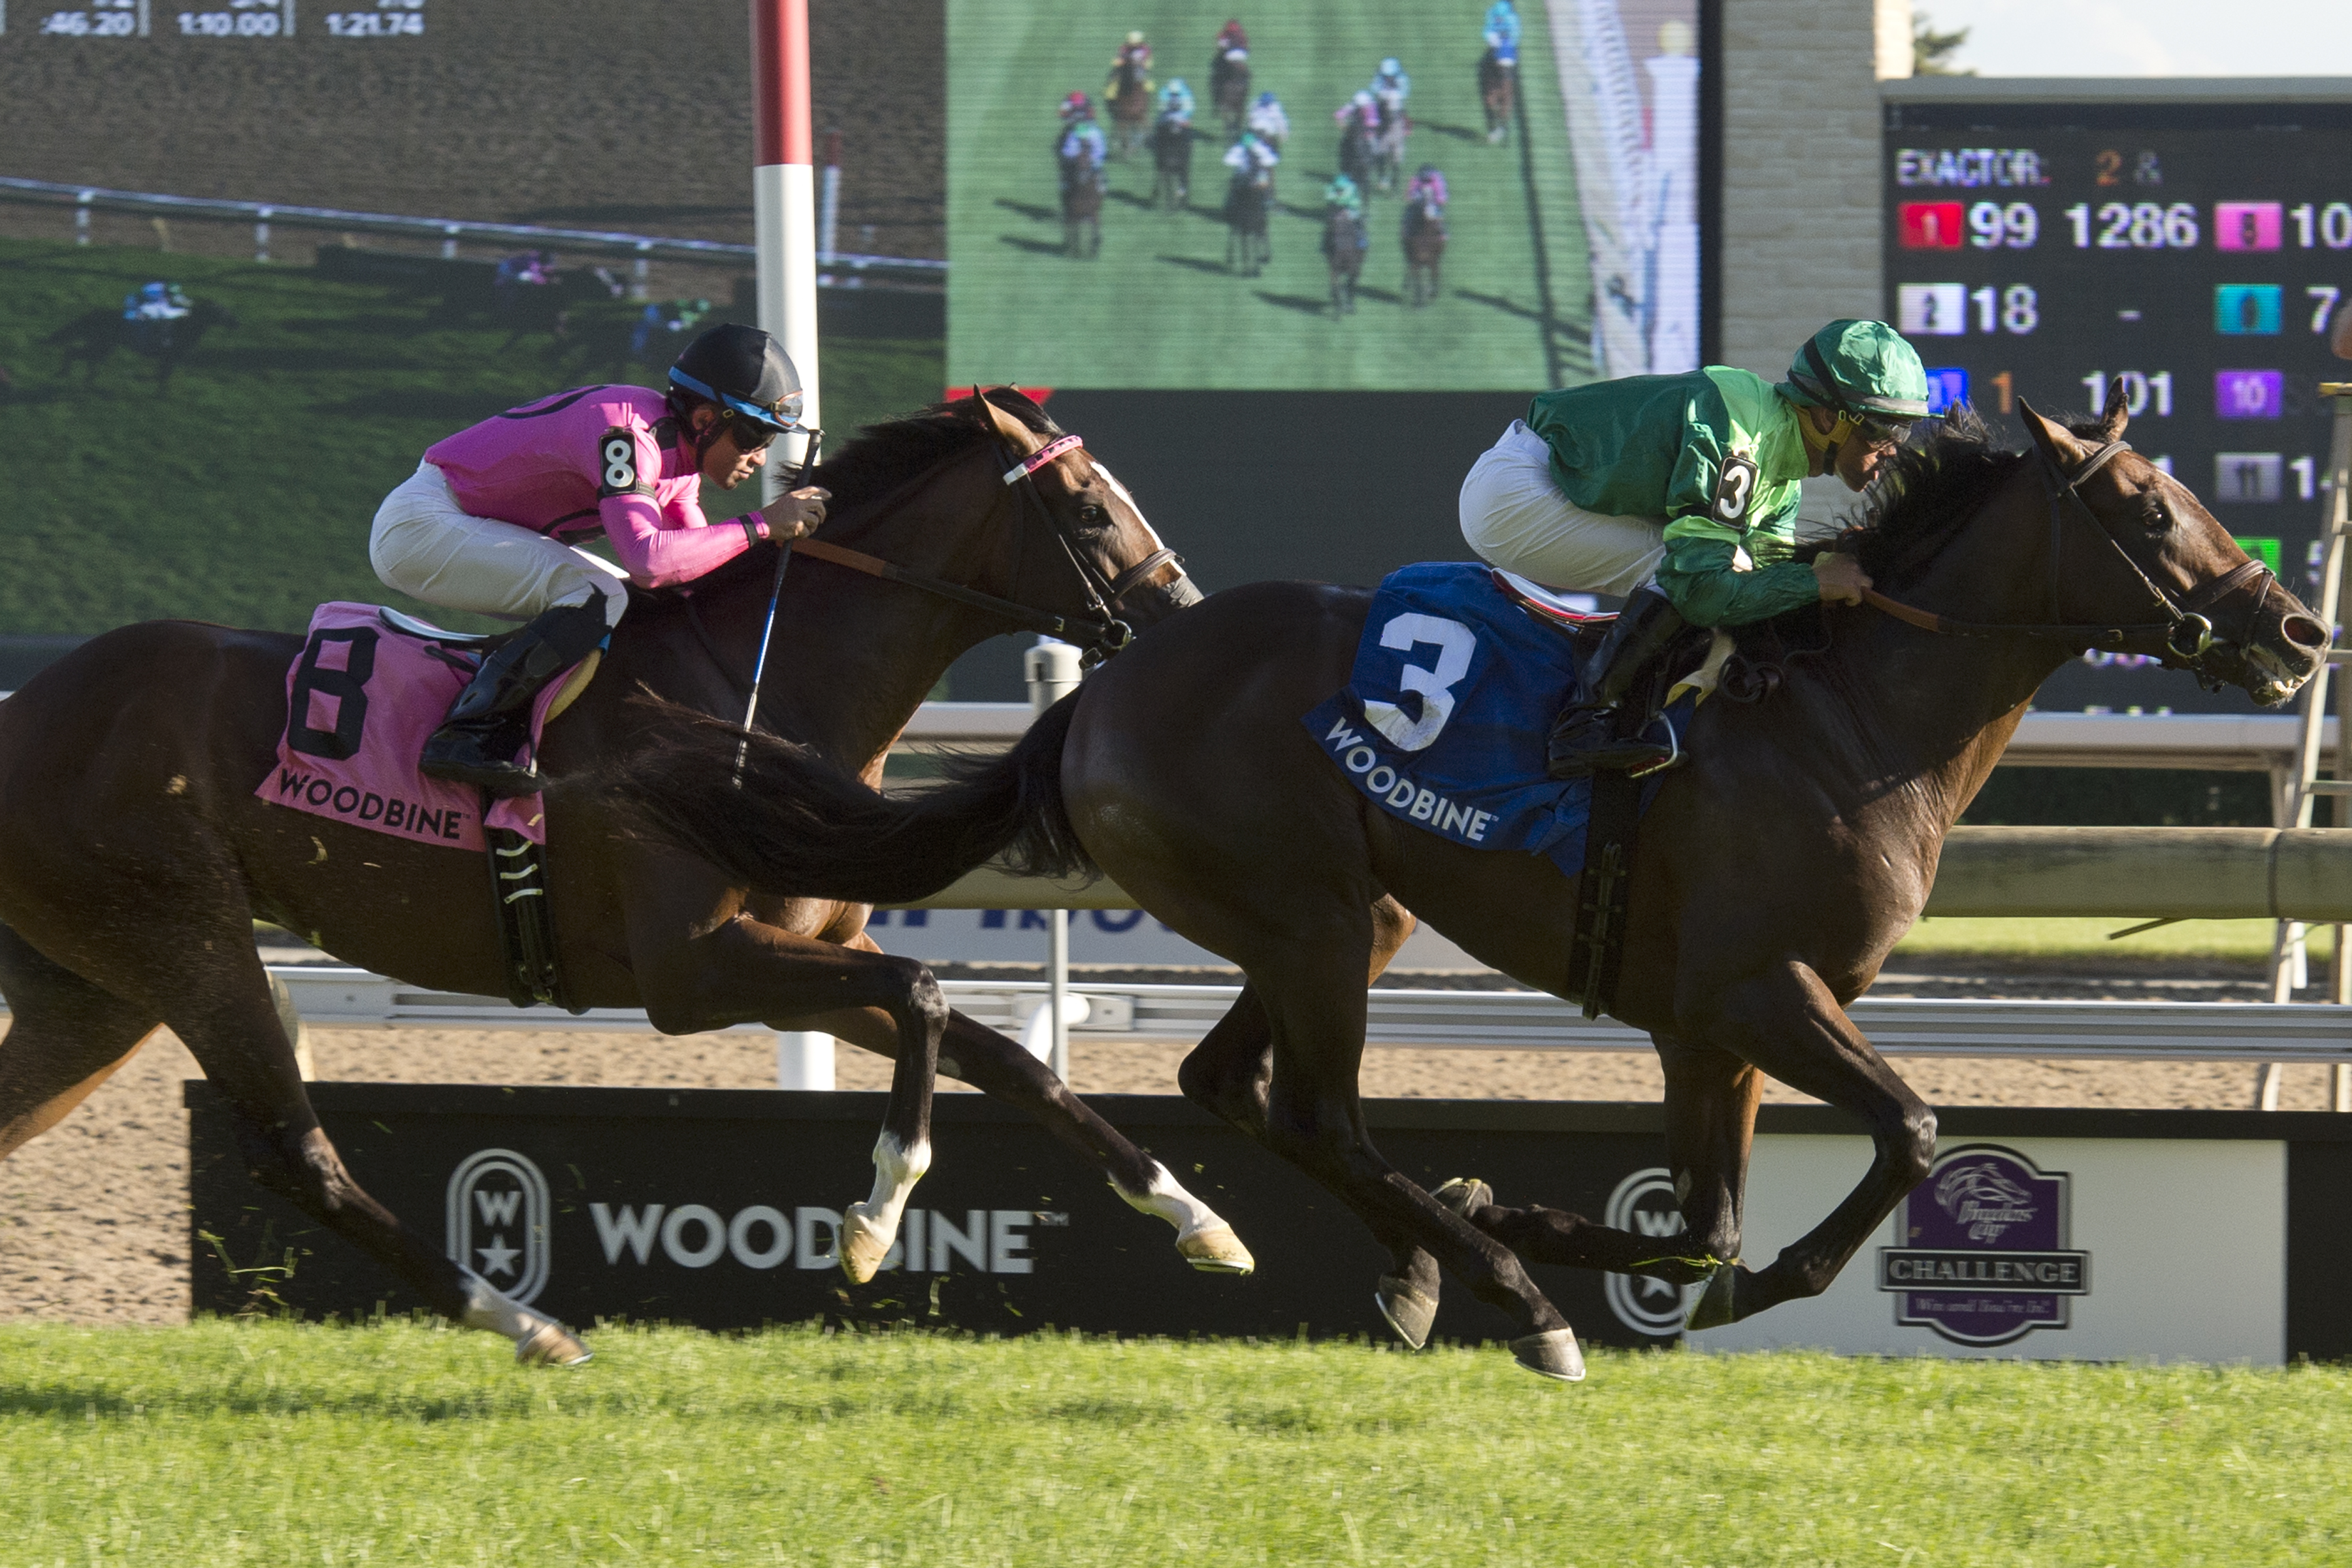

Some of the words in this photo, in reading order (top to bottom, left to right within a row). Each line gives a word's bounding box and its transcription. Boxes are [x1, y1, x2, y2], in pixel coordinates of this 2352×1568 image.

[1968, 201, 2039, 249] 99
[2065, 201, 2199, 250] 1286
[1970, 285, 2039, 333] 18
[2305, 286, 2341, 334] 7
[1991, 370, 2014, 421] 1
[605, 439, 635, 488] 8
[1720, 465, 1751, 519] 3
[288, 626, 382, 761] 8
[1364, 612, 1477, 752] 3
[474, 1189, 523, 1227] W
[1889, 1259, 2079, 1282] CHALLENGE
